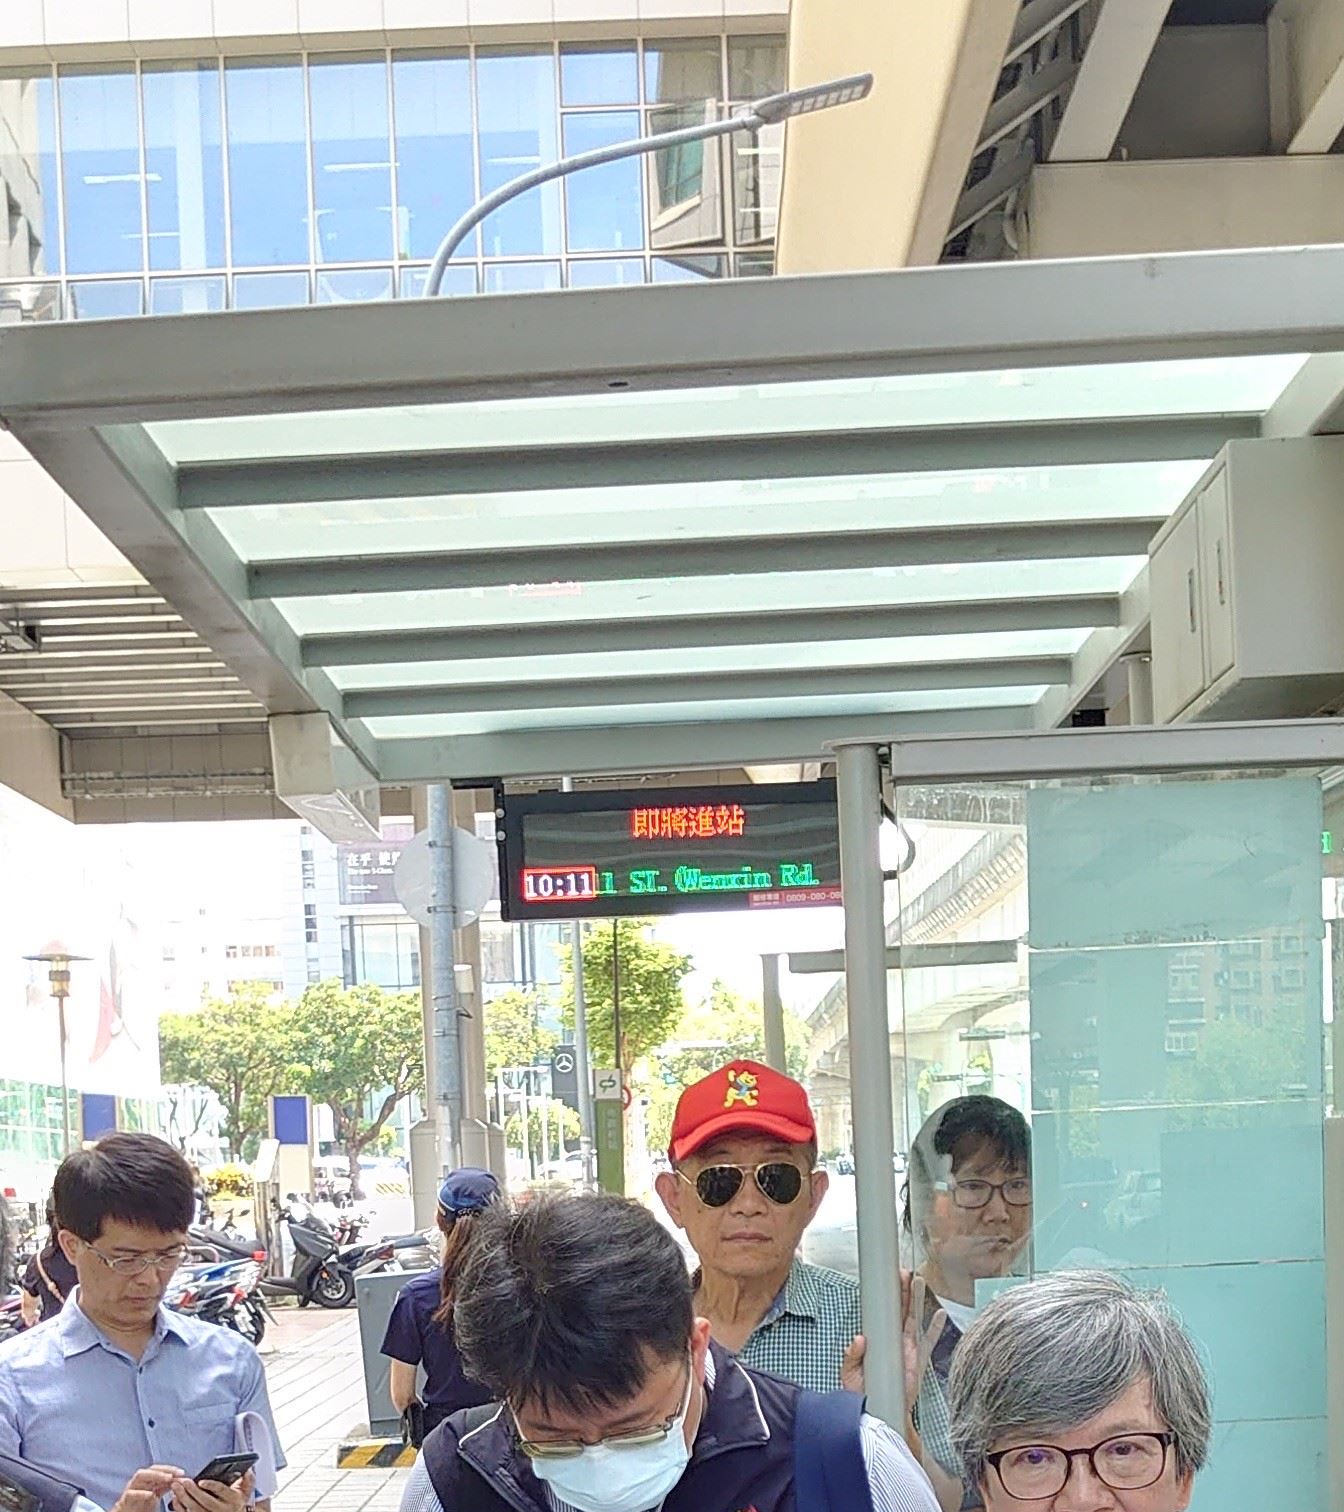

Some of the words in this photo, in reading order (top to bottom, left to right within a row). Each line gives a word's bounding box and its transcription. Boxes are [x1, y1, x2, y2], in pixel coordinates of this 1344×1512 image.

[632, 805, 745, 839] 即將進站
[525, 873, 593, 898] 10:11
[779, 863, 820, 887] Rd.
